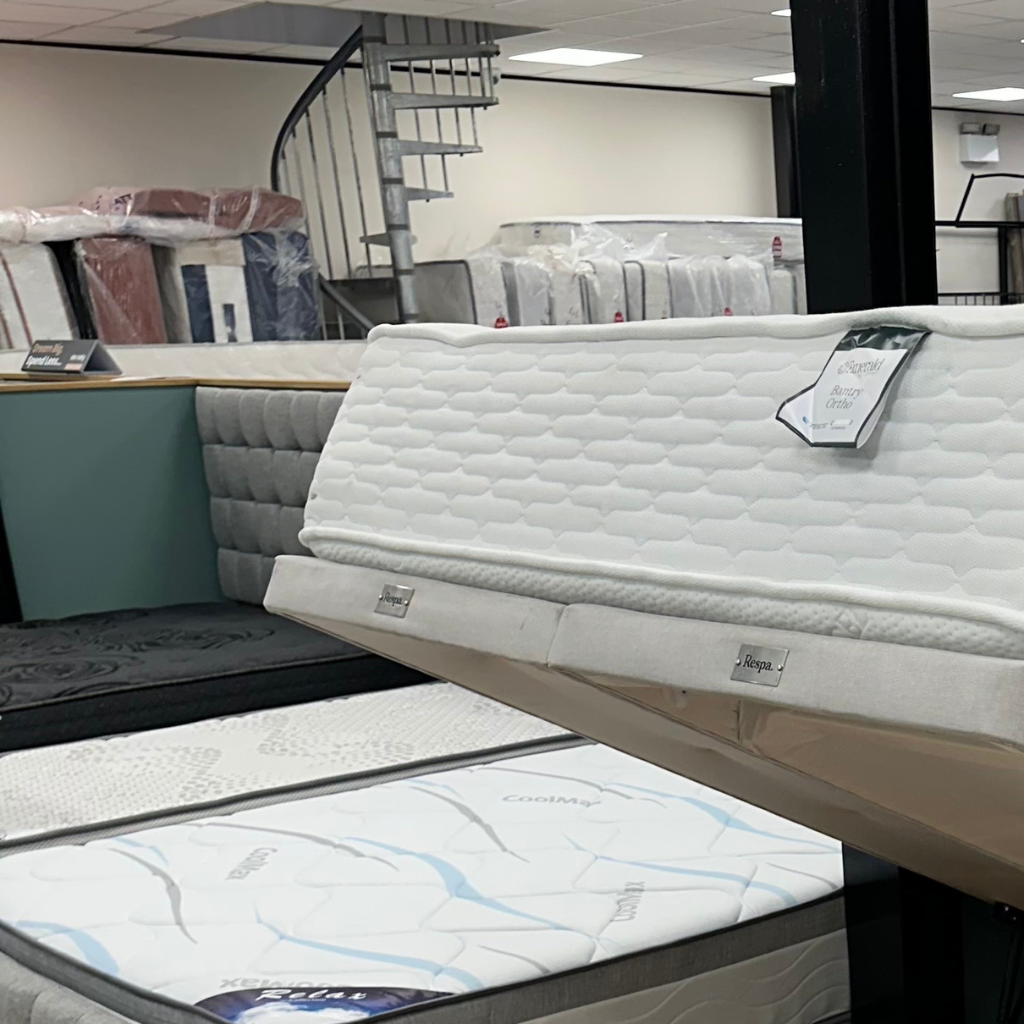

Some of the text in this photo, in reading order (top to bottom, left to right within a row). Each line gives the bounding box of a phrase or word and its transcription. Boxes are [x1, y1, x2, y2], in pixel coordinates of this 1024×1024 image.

[830, 384, 864, 400] Bantry
[826, 398, 854, 410] Ortho
[743, 654, 774, 674] Respa.
[254, 988, 368, 1002] Relax
